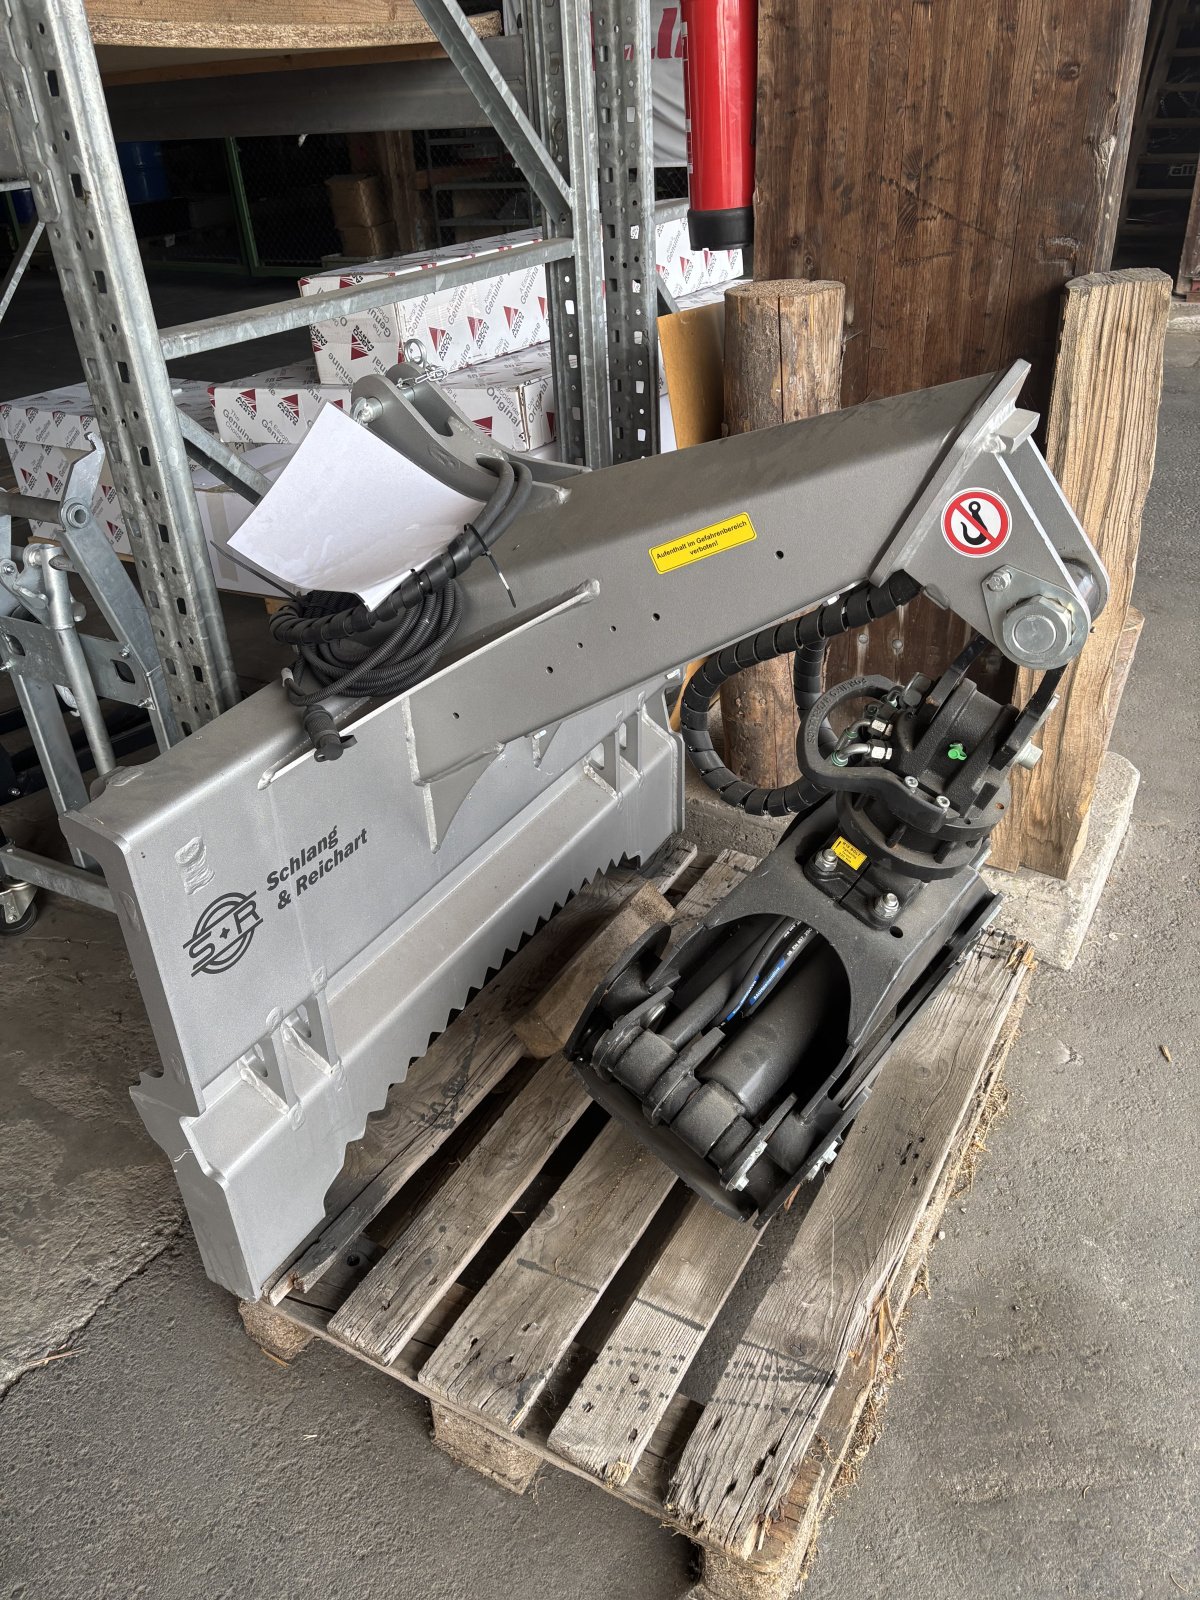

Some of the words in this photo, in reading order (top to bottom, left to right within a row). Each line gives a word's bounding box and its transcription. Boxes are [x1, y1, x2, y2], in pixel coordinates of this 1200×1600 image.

[355, 325, 375, 351] PARTS
[366, 308, 391, 338] Genui
[352, 329, 373, 352] AGCO
[328, 352, 355, 384] enuine
[236, 397, 256, 418] AGCO
[279, 402, 299, 424] AGCO
[487, 387, 521, 427] Original
[529, 379, 549, 423] Original
[657, 542, 687, 559] Aufenthalt
[696, 521, 747, 544] Gefahrenbereich
[690, 540, 719, 555] verboten!
[266, 825, 339, 891] Schlang
[277, 889, 292, 910] &
[296, 828, 368, 896] Reichart
